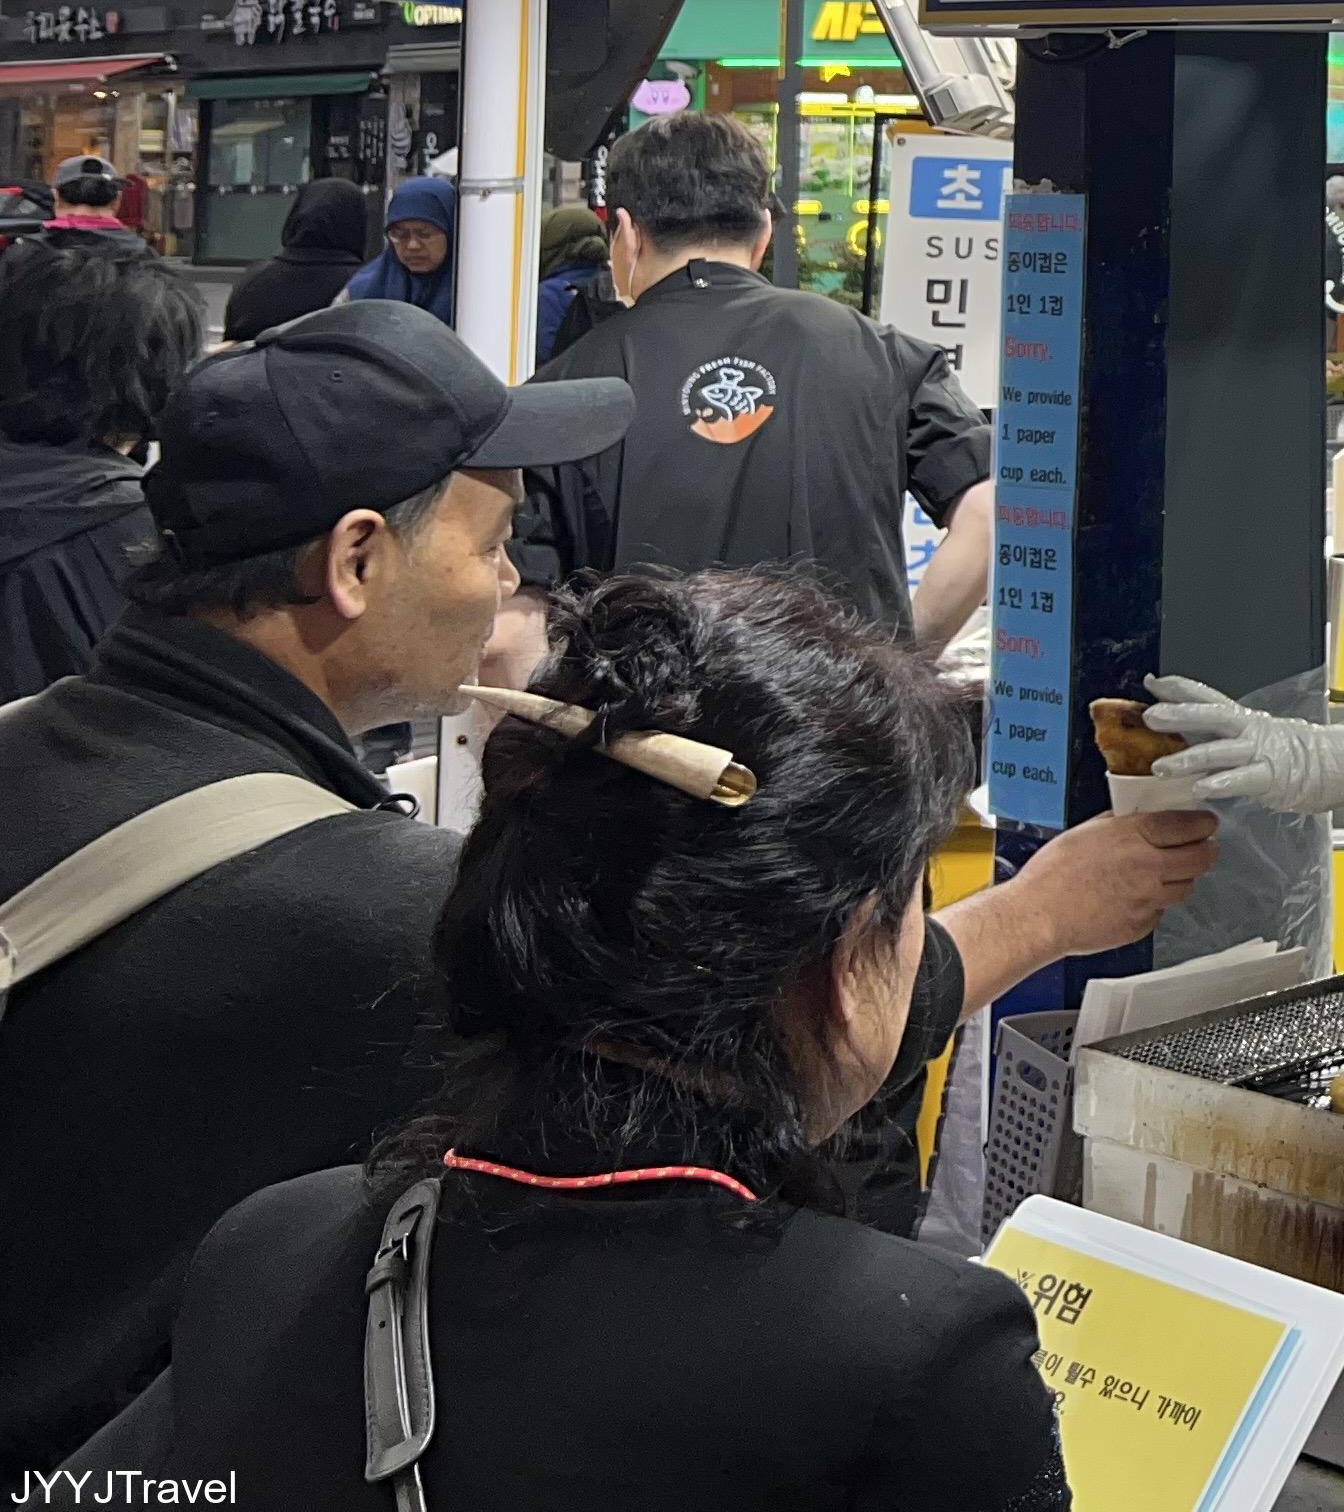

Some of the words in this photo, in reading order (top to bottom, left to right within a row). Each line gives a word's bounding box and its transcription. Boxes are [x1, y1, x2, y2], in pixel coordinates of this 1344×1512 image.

[1006, 251, 1068, 274] 종이컵은
[1007, 294, 1031, 316] 1인
[1039, 295, 1063, 316] 1컵
[1002, 387, 1022, 403] We
[1027, 390, 1072, 407] provide
[1001, 424, 1009, 441] 1
[1016, 428, 1056, 445] paper
[999, 466, 1023, 484] cup
[1030, 466, 1067, 485] each.
[999, 544, 1057, 571] 종이컵은
[999, 587, 1023, 610] 1인
[1031, 591, 1054, 613] 1컵
[993, 680, 1013, 698] We
[1019, 685, 1063, 706] provide
[994, 717, 1002, 735] 1
[1009, 722, 1047, 743] paper
[992, 760, 1016, 780] cup
[1023, 762, 1057, 786] each.
[1098, 1375, 1150, 1411] 있으니
